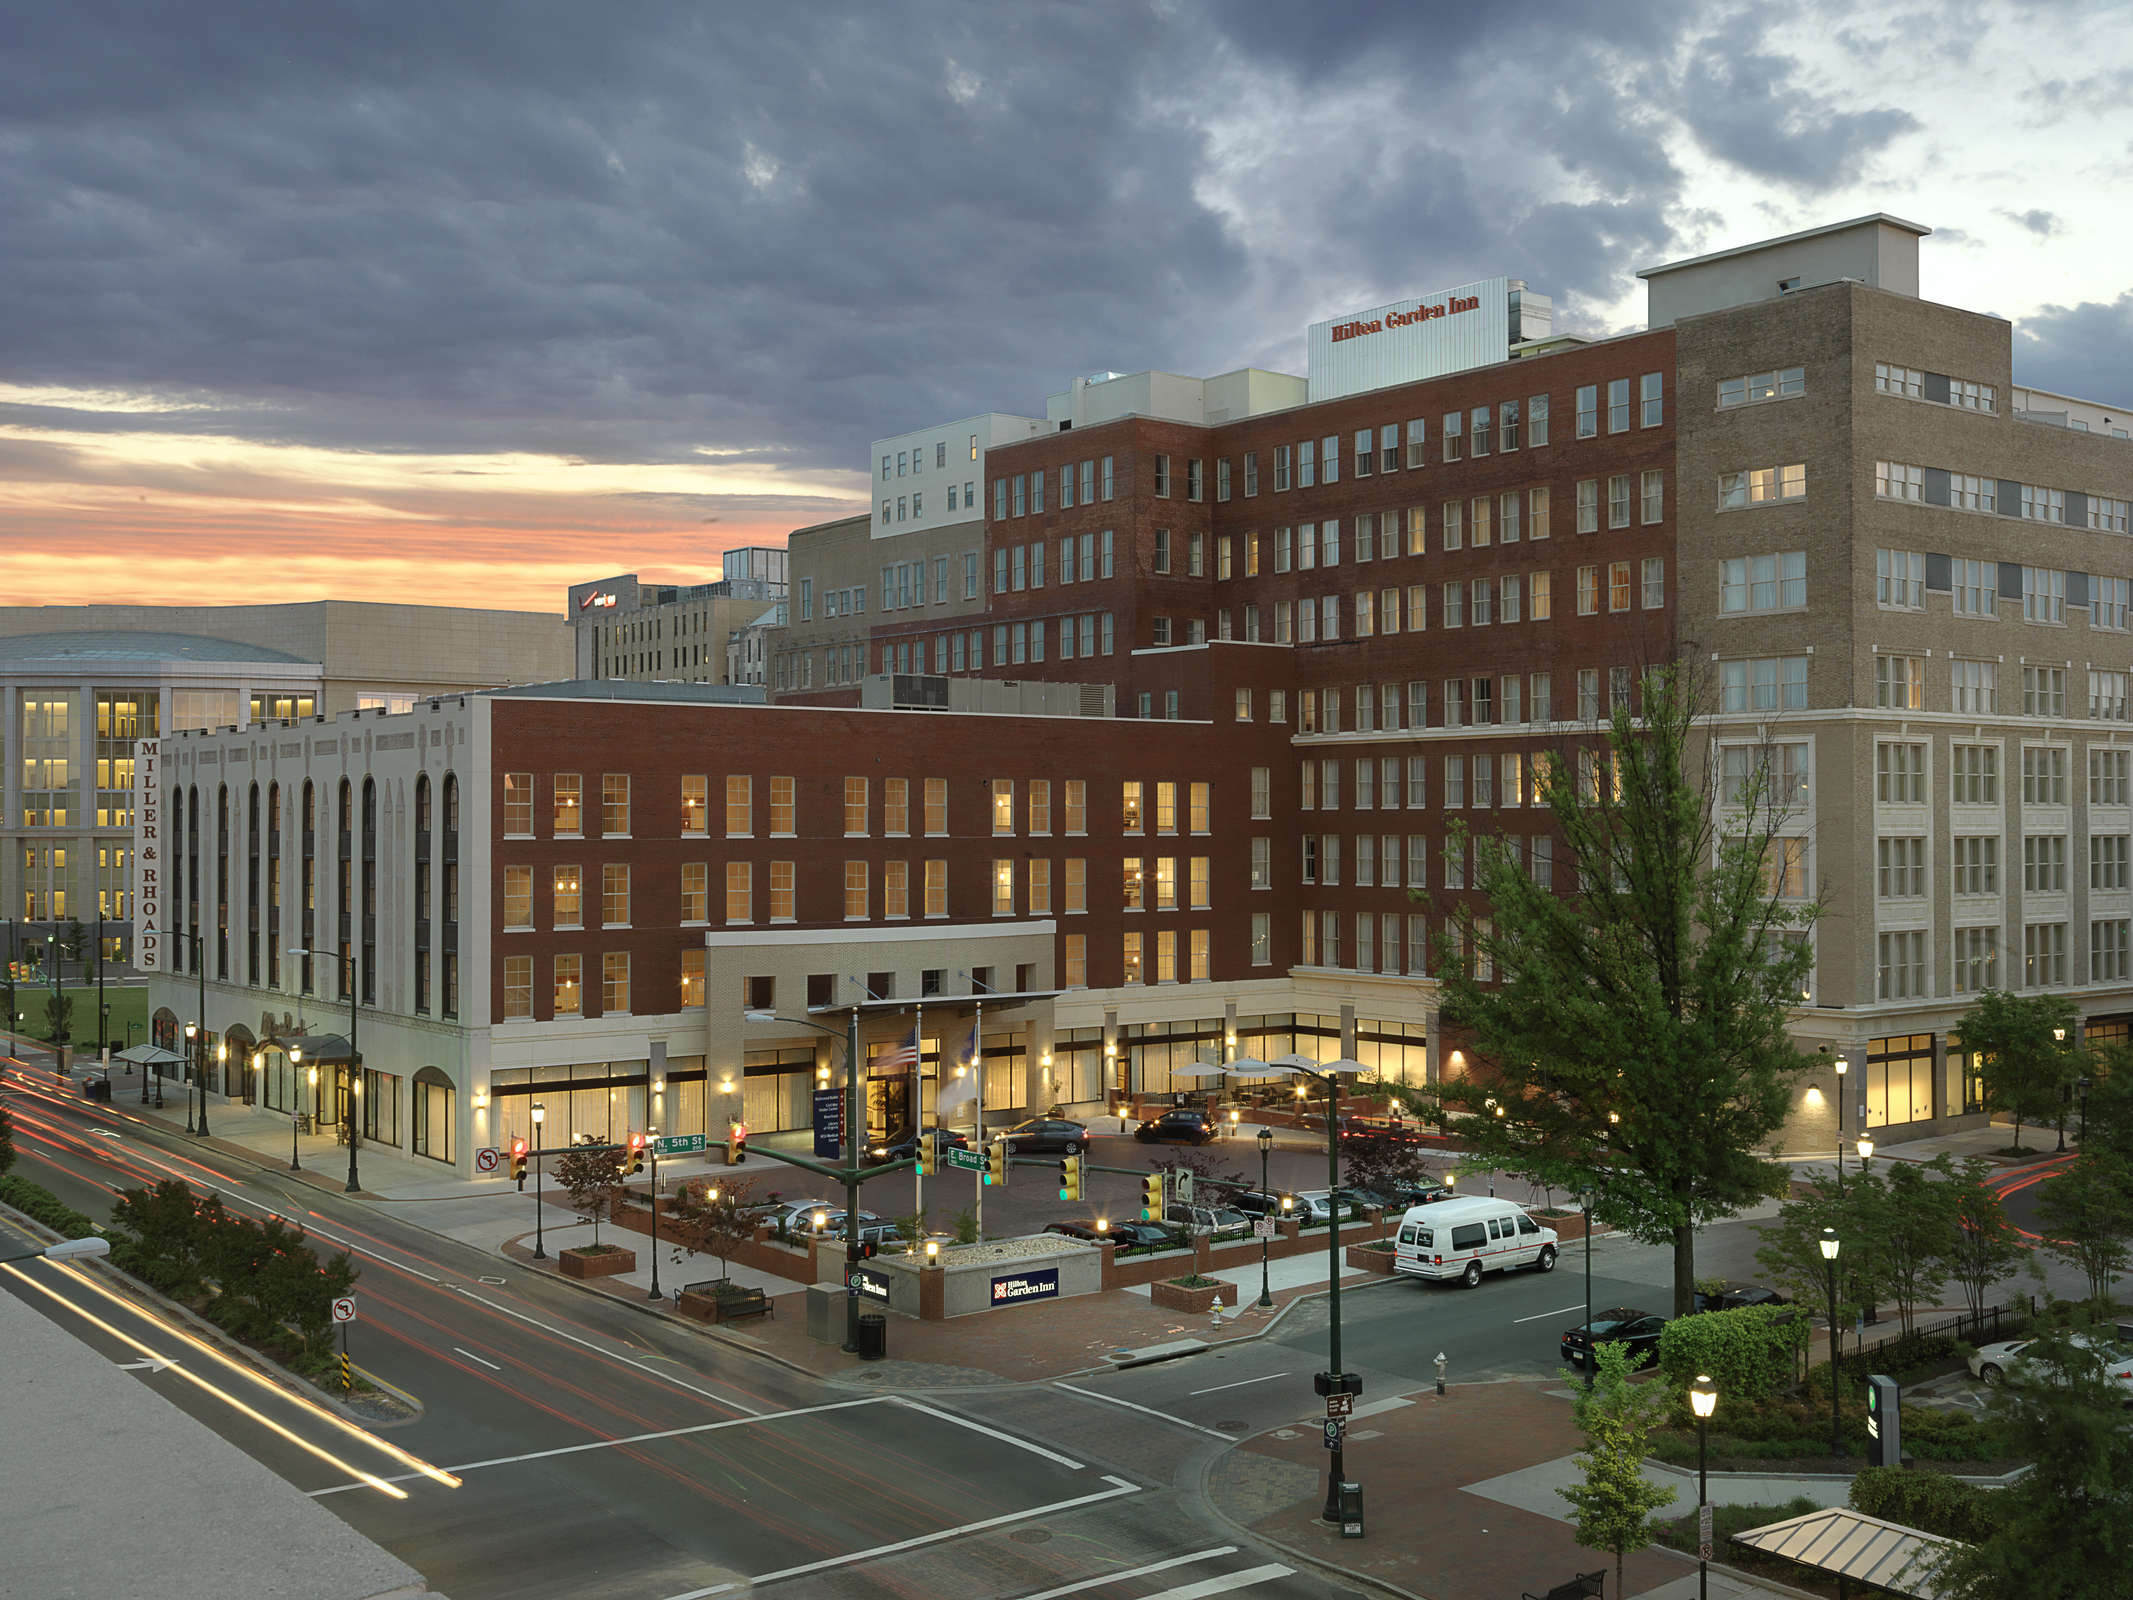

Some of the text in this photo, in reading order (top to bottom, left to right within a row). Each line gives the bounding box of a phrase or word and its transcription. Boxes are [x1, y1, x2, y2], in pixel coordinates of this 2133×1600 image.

[1331, 296, 1480, 342] Hilton Garden Inn
[142, 742, 158, 966] MILLER & RHOADS
[657, 1136, 702, 1148] N. 5th St
[959, 1151, 977, 1164] Broad
[1178, 1191, 1190, 1200] ONLY
[876, 1283, 887, 1296] Inn
[1007, 1280, 1028, 1289] Hilton
[1007, 1285, 1038, 1297] Garden
